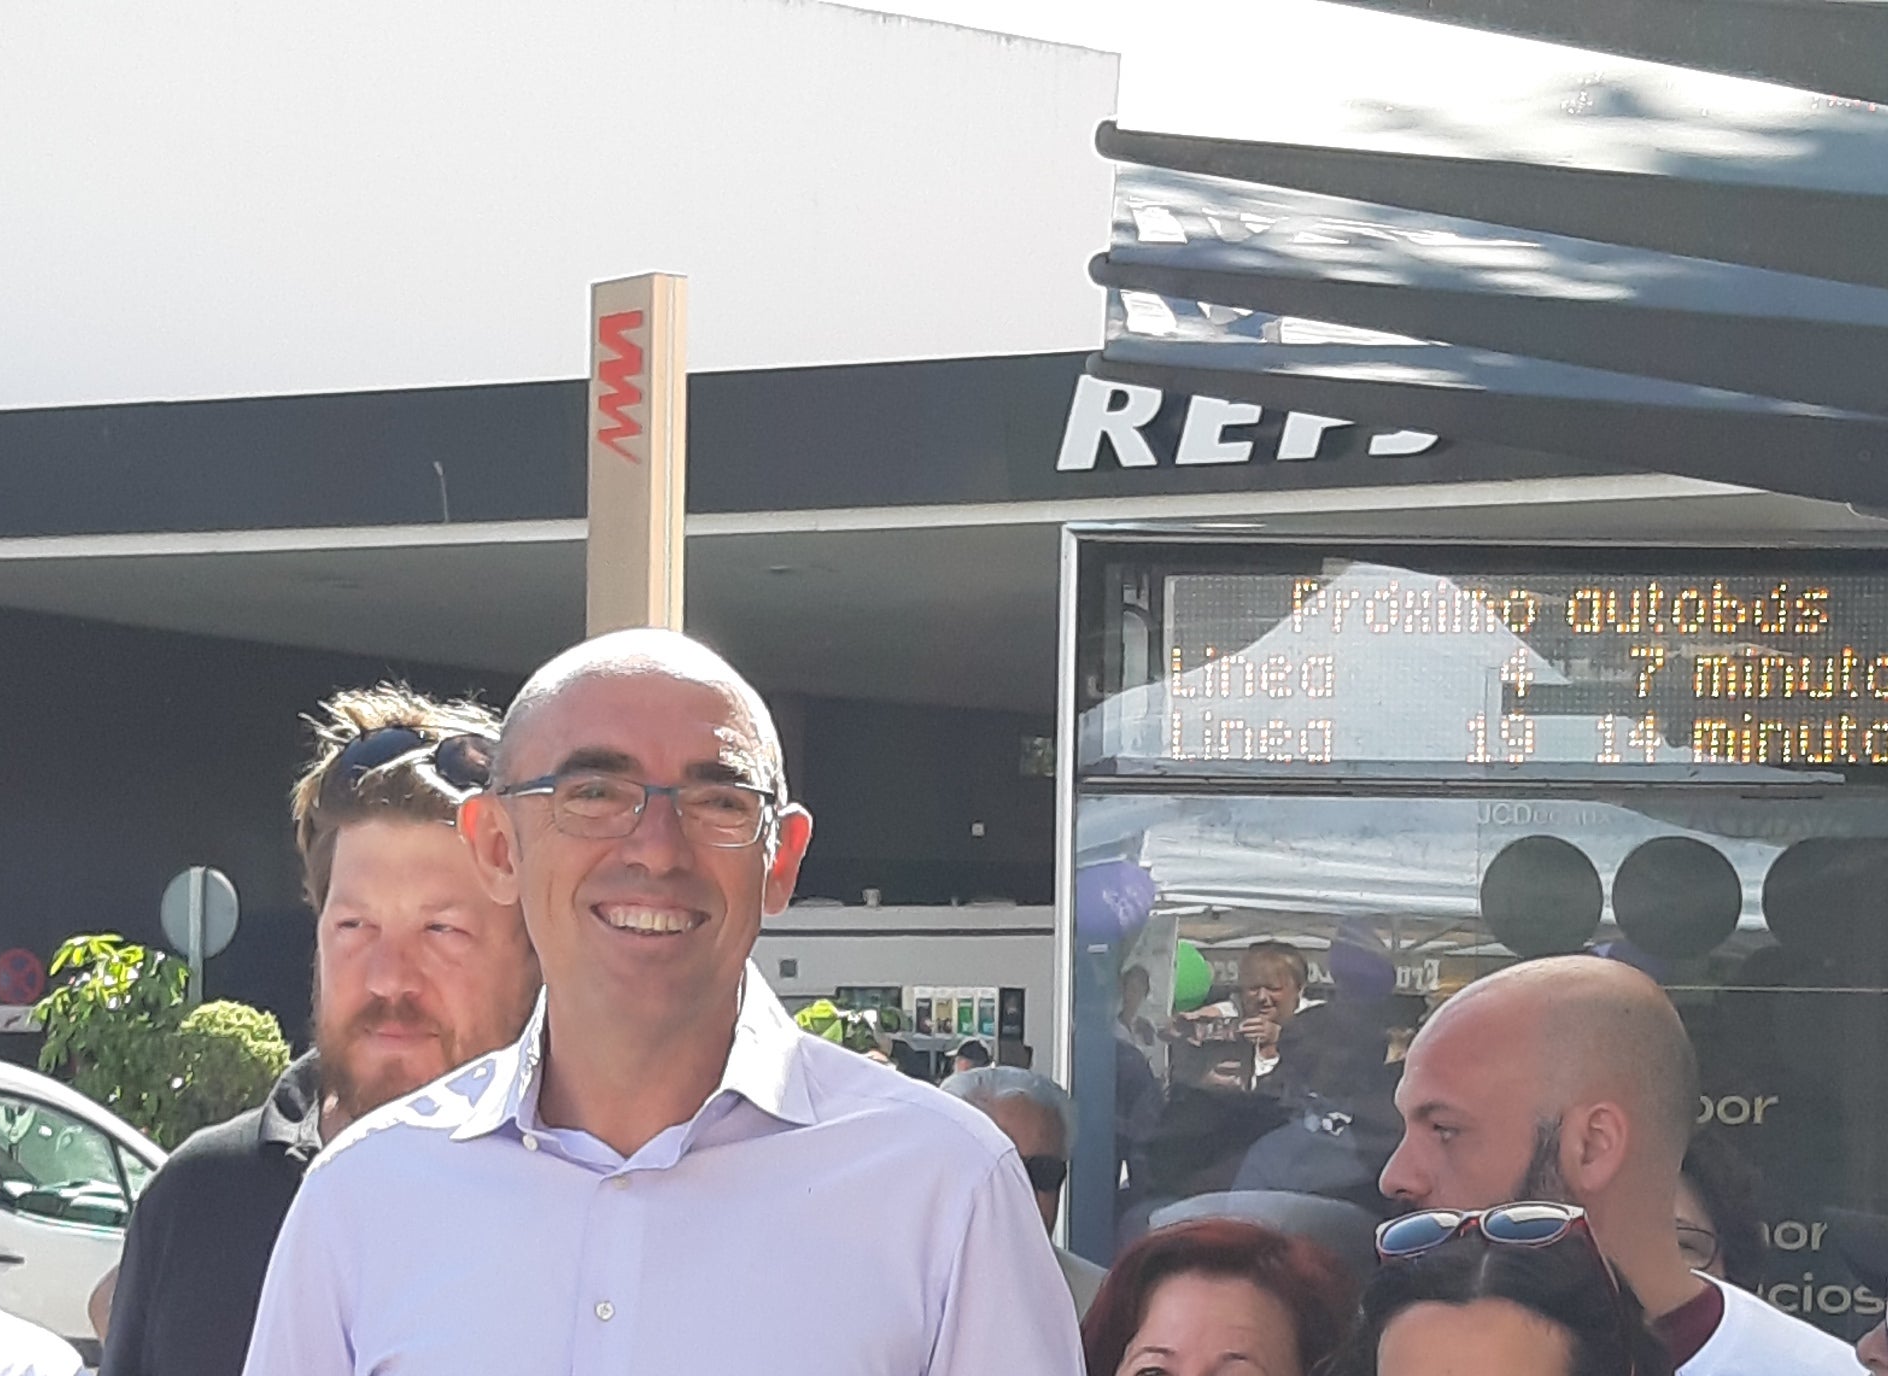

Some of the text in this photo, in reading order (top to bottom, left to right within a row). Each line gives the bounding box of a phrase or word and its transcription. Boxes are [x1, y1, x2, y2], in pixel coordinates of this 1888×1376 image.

[1292, 579, 1829, 634] Próximo autobús
[1500, 647, 1534, 697] 4
[1630, 646, 1664, 697] 7
[1466, 711, 1534, 763] 19
[1596, 711, 1661, 763] 14
